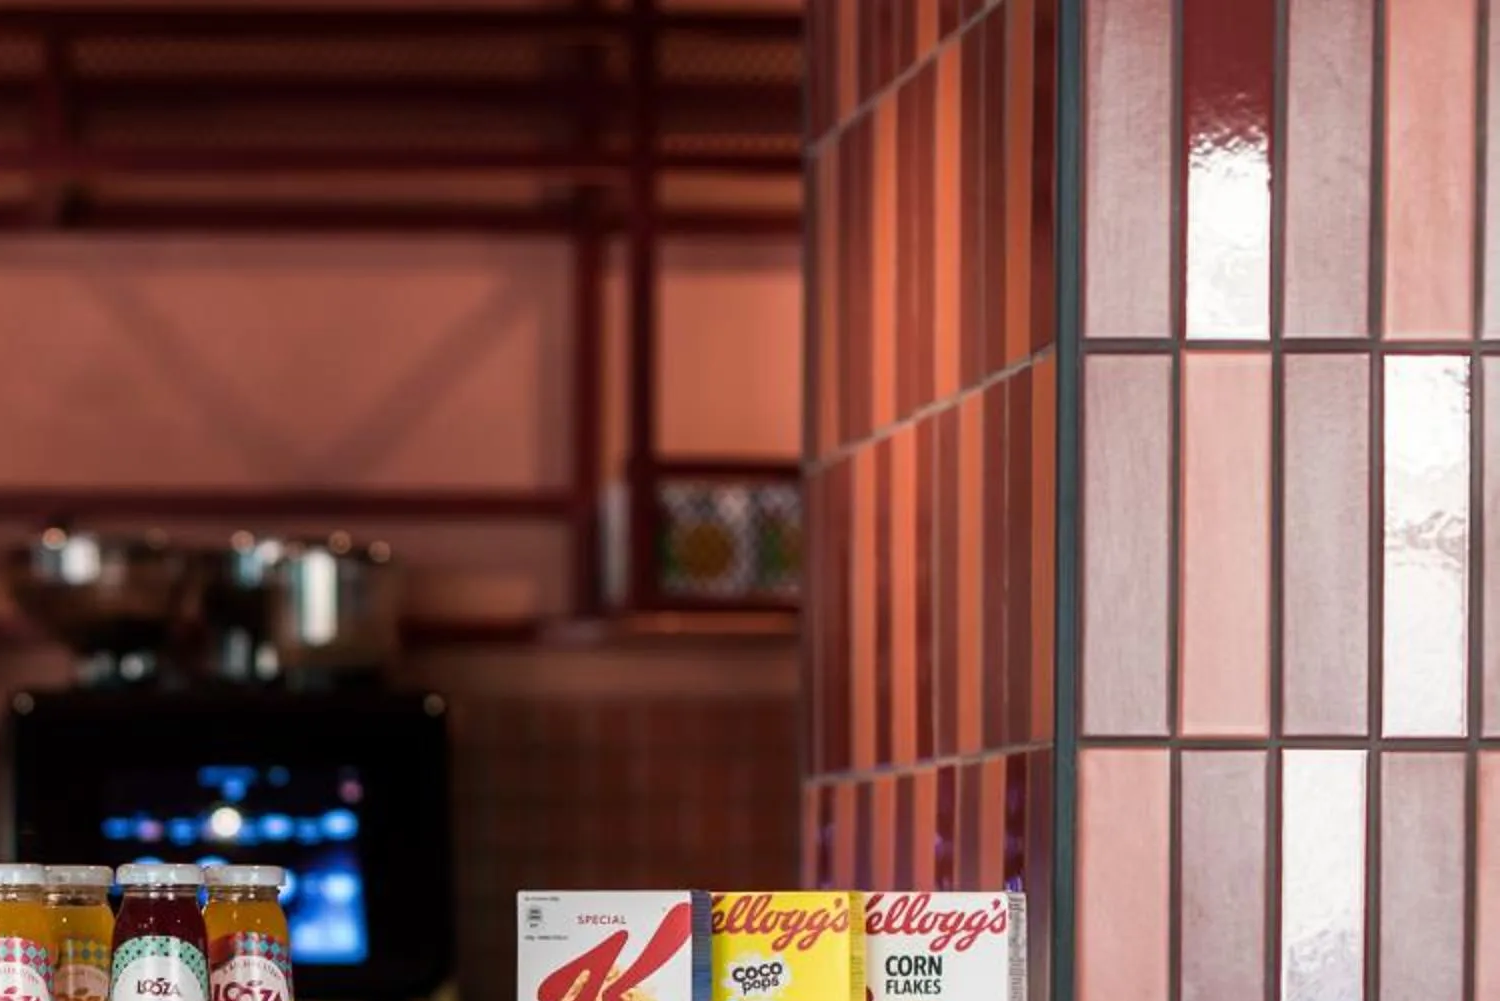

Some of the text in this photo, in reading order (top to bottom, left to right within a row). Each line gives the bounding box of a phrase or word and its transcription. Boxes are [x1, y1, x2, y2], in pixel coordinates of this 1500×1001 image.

[576, 913, 627, 925] SPECIAL
[712, 894, 849, 952] ellogg's
[866, 893, 1008, 952] ellogg's
[885, 955, 943, 977] CORN
[885, 979, 942, 995] FLAKES
